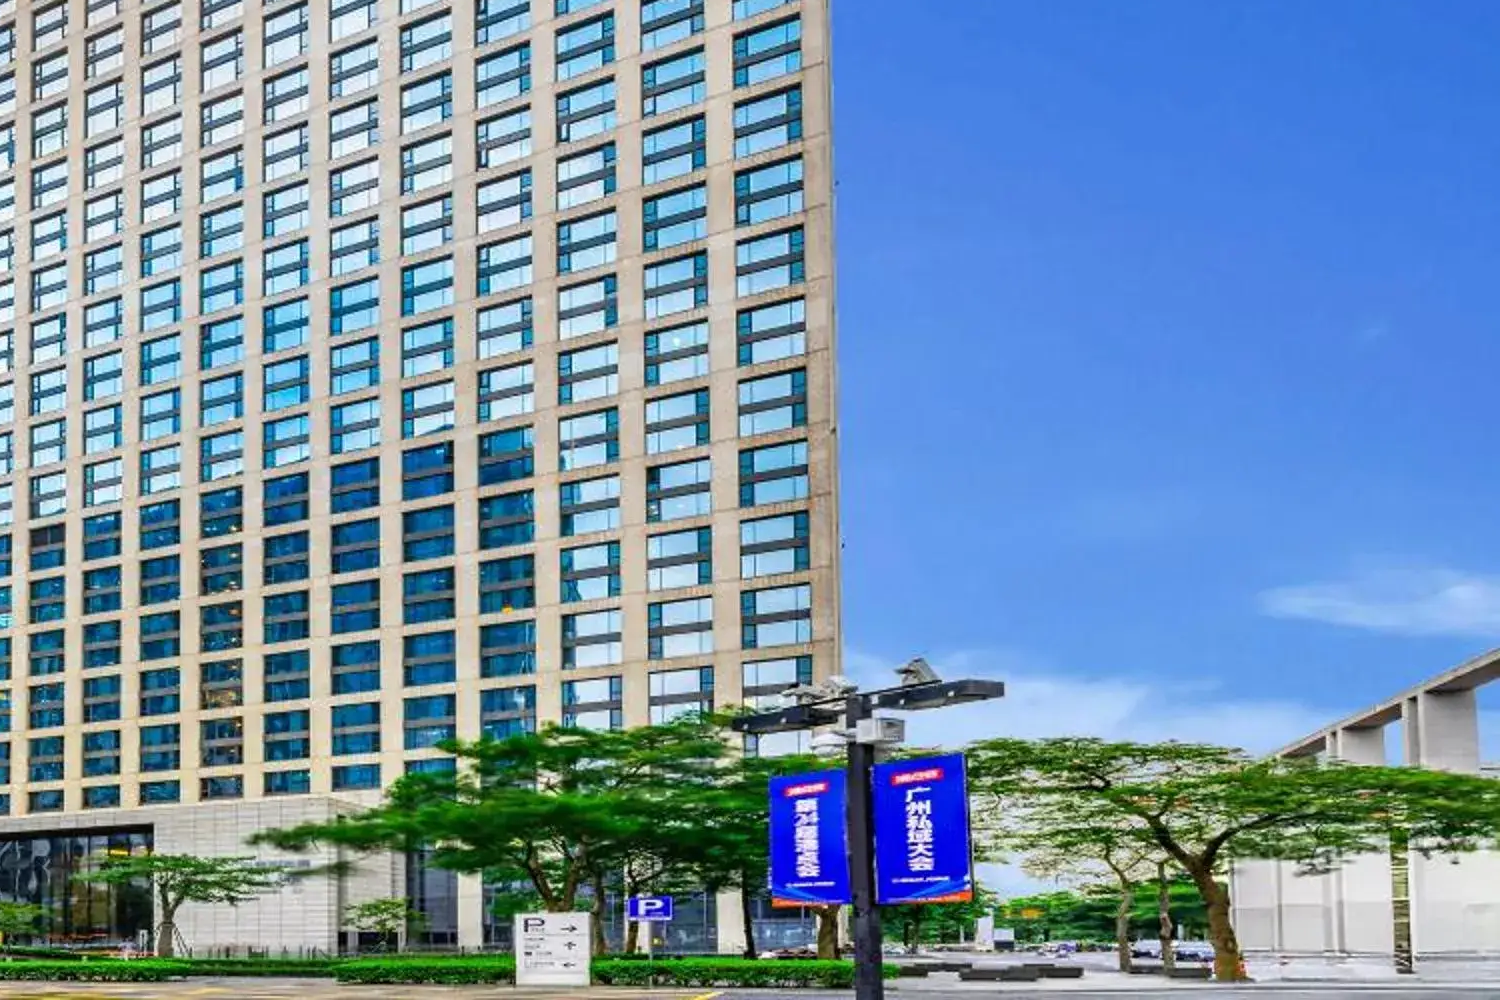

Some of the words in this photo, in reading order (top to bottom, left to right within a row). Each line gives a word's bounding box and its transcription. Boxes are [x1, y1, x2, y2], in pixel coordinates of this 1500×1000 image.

[905, 787, 935, 871] 广州私域大会
[638, 899, 664, 916] P
[523, 917, 546, 933] P
